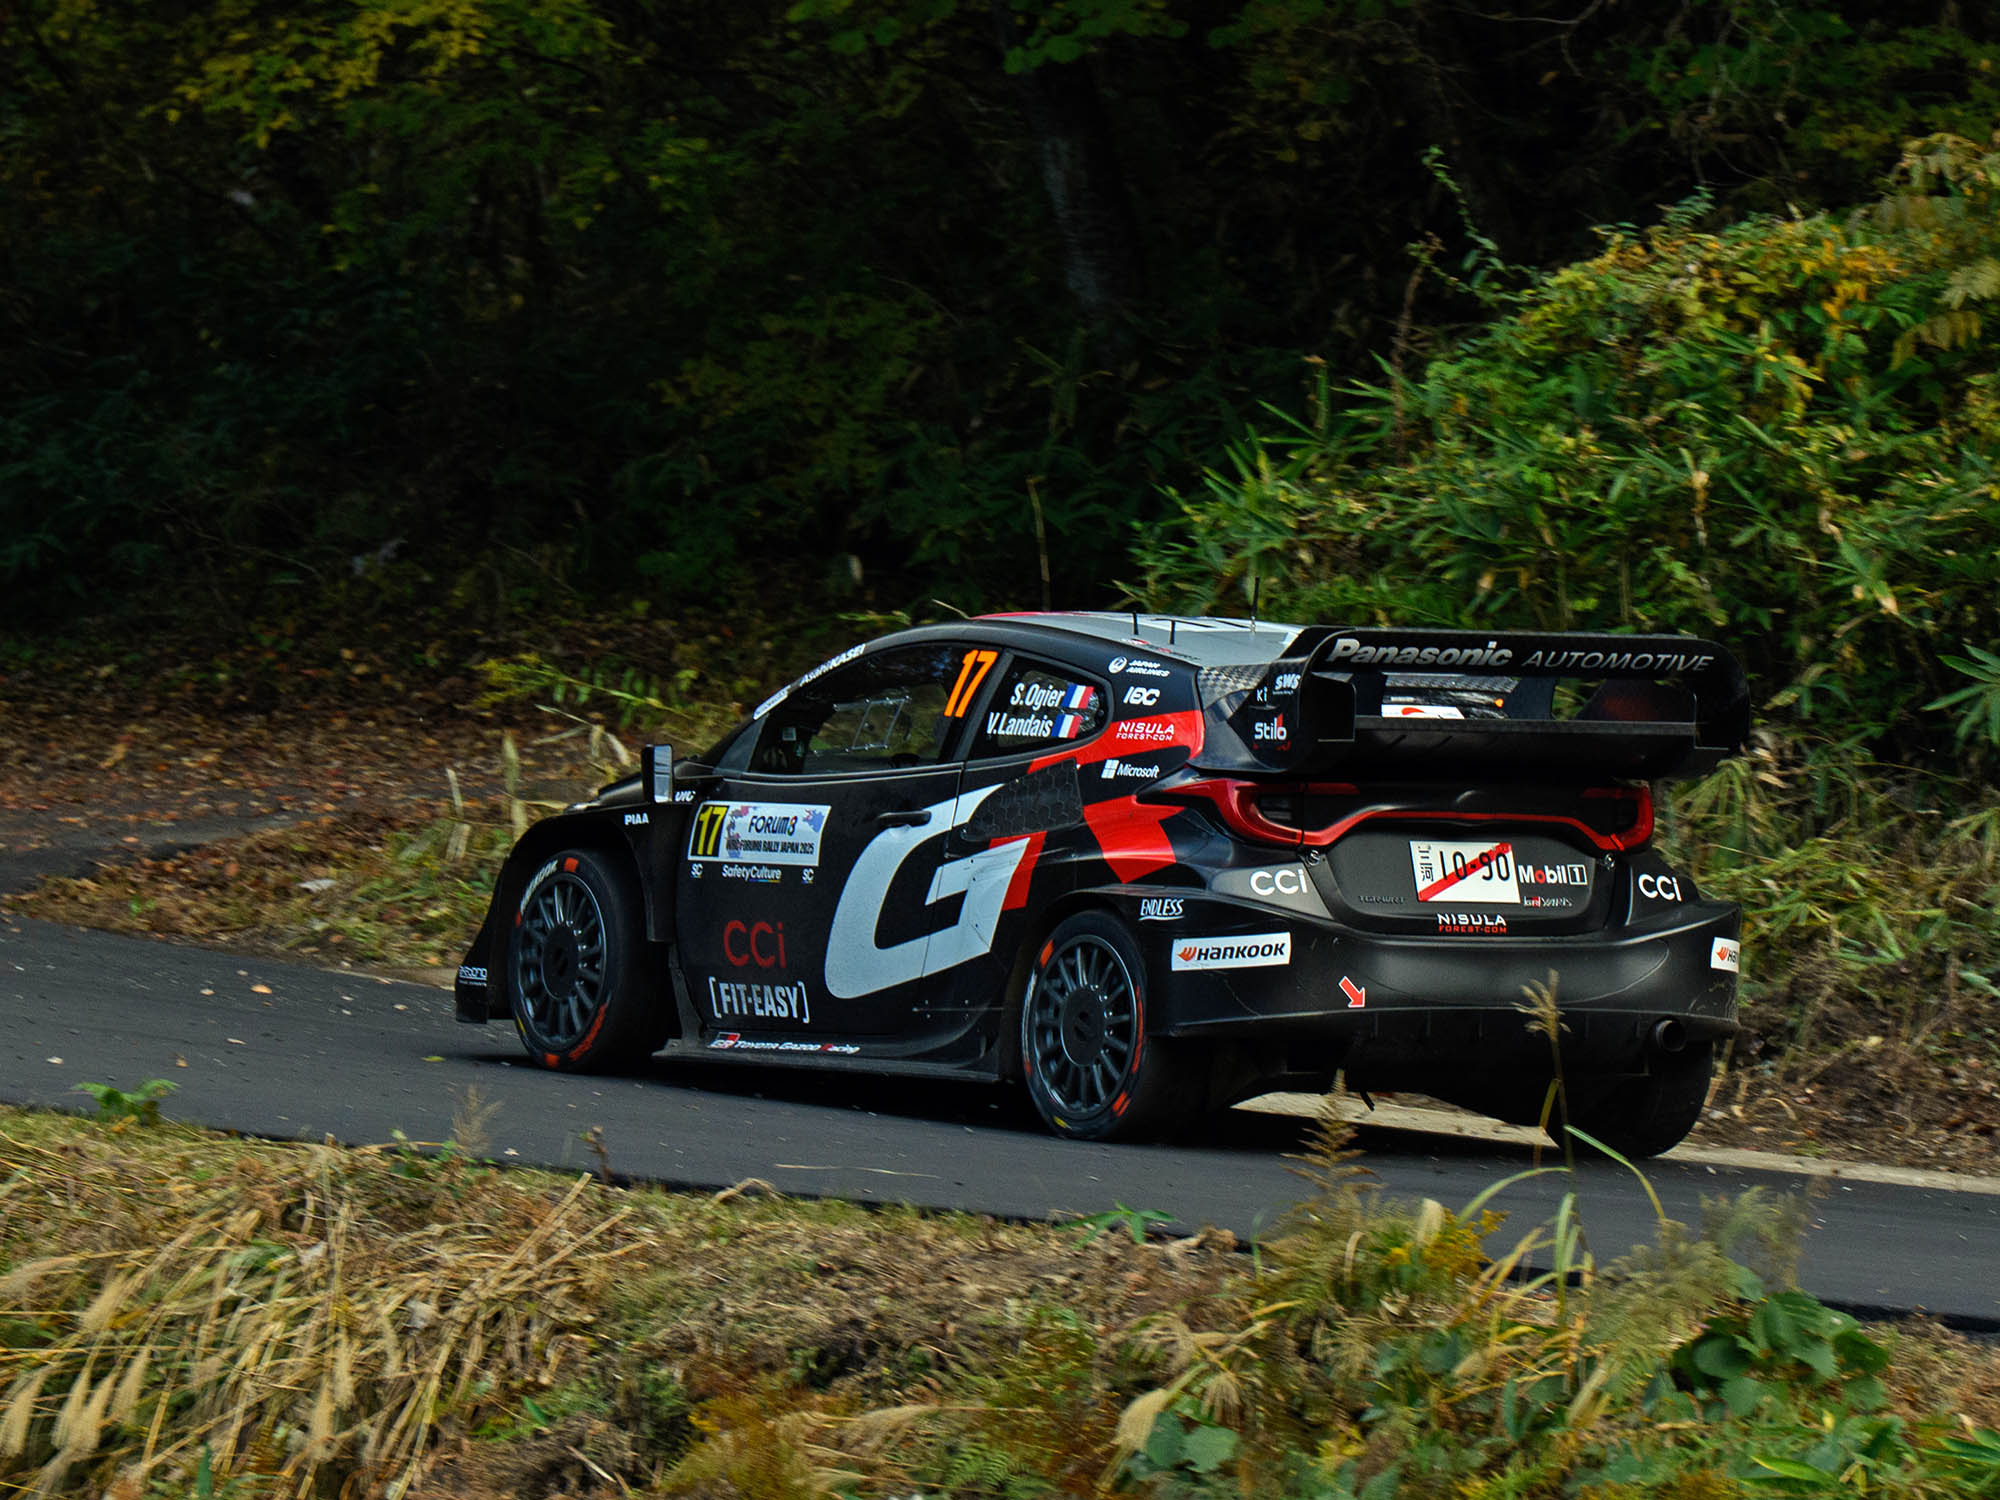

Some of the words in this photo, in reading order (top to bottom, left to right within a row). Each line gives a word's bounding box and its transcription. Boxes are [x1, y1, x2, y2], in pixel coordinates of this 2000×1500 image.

[1128, 659, 1161, 669] JAPAN
[1326, 638, 1513, 666] Panasonic
[1521, 650, 1714, 672] AUTOMOTIVE
[1126, 666, 1171, 677] AIRLINES
[943, 649, 999, 718] 17
[1010, 682, 1066, 711] S.Ogier
[986, 711, 1053, 738] V.Landais
[1118, 721, 1175, 735] NISULA
[1254, 716, 1287, 741] Stilo
[1117, 763, 1160, 779] Microsoft
[624, 812, 649, 825] PIAA
[748, 815, 798, 836] FORUM8
[698, 805, 728, 856] 17
[722, 863, 782, 882] SafetyCulture
[1517, 864, 1568, 884] Mobil
[1140, 898, 1184, 916] ENDLESS
[1436, 912, 1507, 926] NISULA
[1195, 942, 1286, 961] HANKOOK
